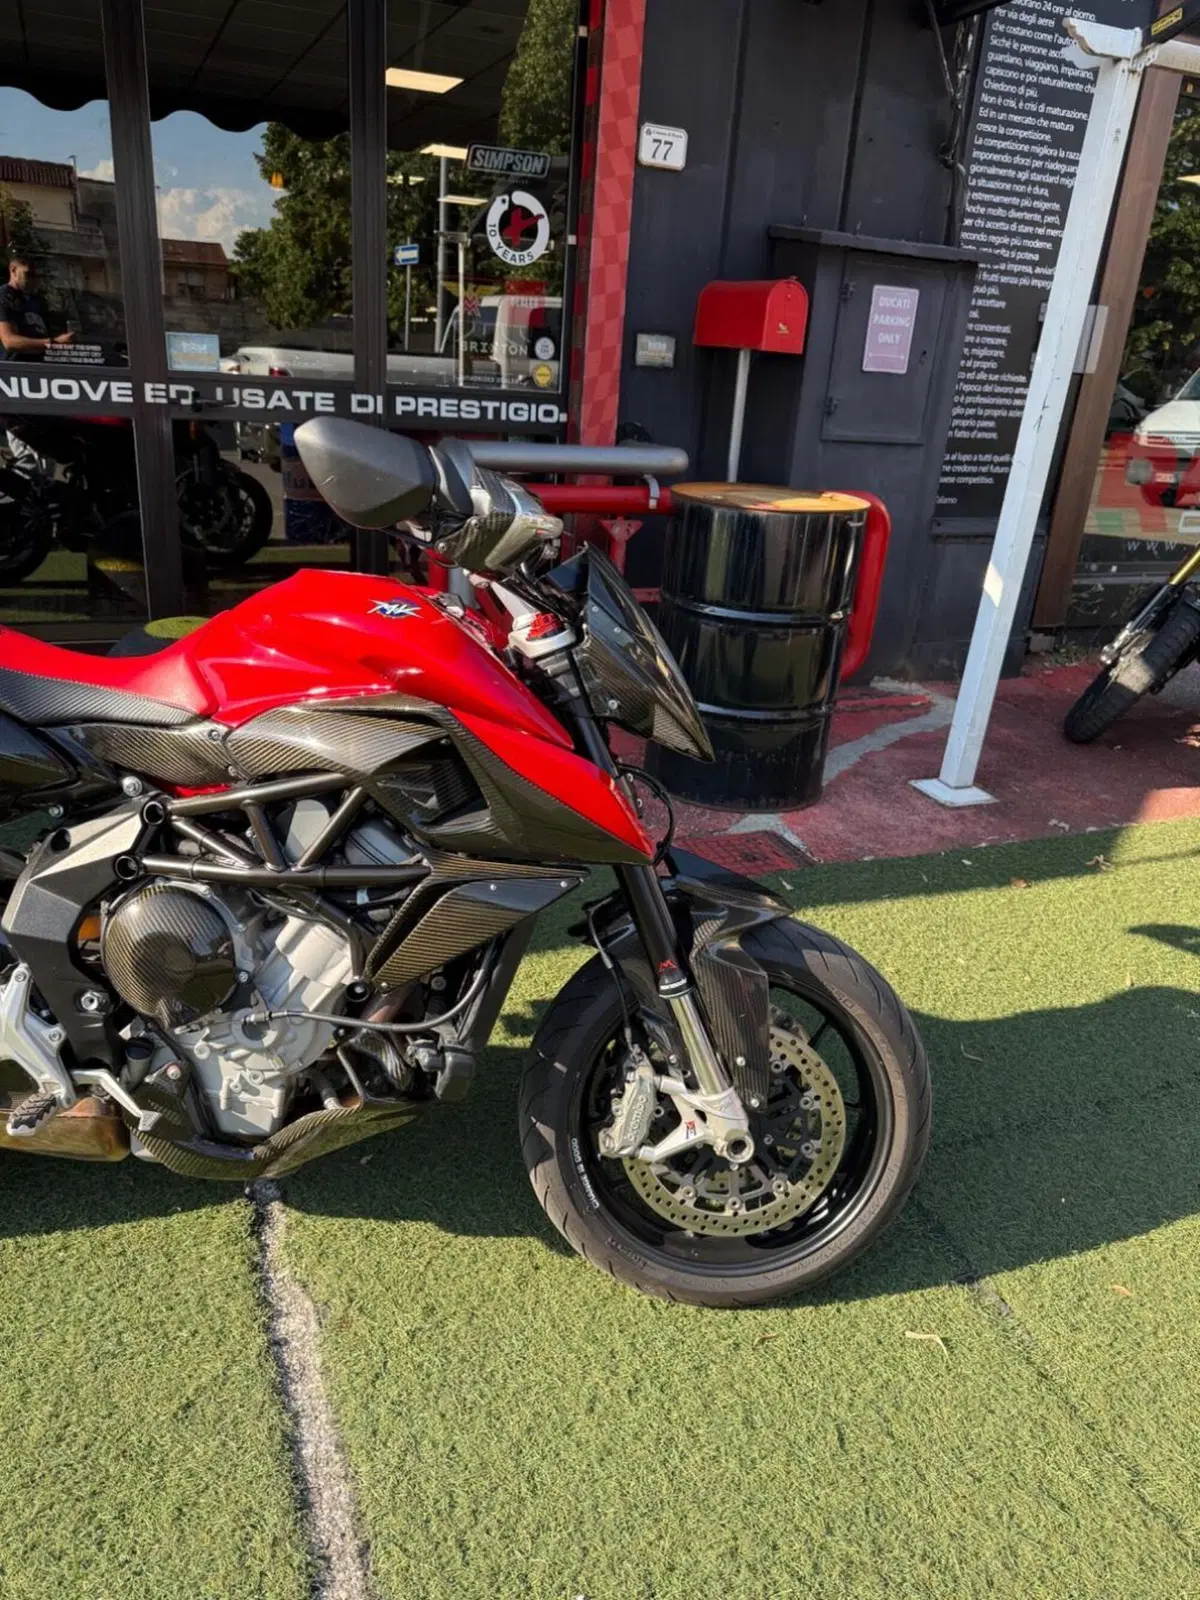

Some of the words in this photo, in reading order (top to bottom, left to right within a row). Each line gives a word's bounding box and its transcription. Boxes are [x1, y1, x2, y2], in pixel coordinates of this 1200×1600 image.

[994, 6, 1006, 17] Per
[1008, 9, 1018, 20] via
[1019, 11, 1037, 25] degli
[1042, 2, 1052, 12] 24
[1052, 5, 1065, 14] ore
[1065, 6, 1073, 16] al
[992, 21, 1005, 32] che
[1006, 25, 1034, 38] costano
[1034, 31, 1054, 42] come
[990, 34, 1012, 48] Sicché
[1012, 40, 1020, 50] le
[1020, 43, 1048, 56] persone
[988, 52, 1024, 67] guardano,
[1024, 58, 1060, 75] viaggiano,
[983, 78, 1018, 92] Chiedono
[1018, 85, 1025, 95] di
[985, 66, 1020, 80] capiscono
[1026, 74, 1037, 84] poi
[1038, 76, 1084, 92] naturalmente
[980, 92, 996, 104] Non
[997, 96, 1002, 105] è
[1002, 98, 1018, 110] crisi,
[1018, 99, 1024, 109] è
[1024, 101, 1038, 112] crisi
[1038, 102, 1046, 112] di
[976, 122, 997, 132] cresce
[998, 124, 1005, 134] la
[978, 106, 989, 117] Ed
[989, 108, 996, 118] in
[997, 112, 1007, 120] un
[1008, 112, 1036, 125] mercato
[1036, 116, 1050, 128] che
[1050, 120, 1075, 132] matura
[651, 138, 674, 161] 77
[974, 134, 983, 145] La
[984, 138, 1030, 152] competizione
[1030, 144, 1058, 157] migliora
[1058, 148, 1066, 158] la
[1066, 150, 1080, 160] razz
[474, 148, 545, 174] SIMPSON
[972, 148, 1012, 162] imponendo
[1032, 158, 1044, 169] per
[970, 163, 1016, 178] giornalmente
[1016, 169, 1030, 182] agli
[1030, 171, 1060, 184] standard
[968, 176, 976, 186] La
[977, 178, 1012, 191] situazione
[1012, 182, 1026, 193] non
[1027, 184, 1032, 194] è
[972, 191, 1020, 206] estremamente
[1020, 197, 1032, 208] più
[986, 206, 1008, 218] molto
[974, 218, 984, 228] chi
[985, 220, 1010, 231] accetta
[1010, 222, 1018, 232] di
[1018, 224, 1034, 234] stare
[1034, 226, 1046, 236] nel
[988, 235, 1010, 246] regole
[1010, 236, 1022, 247] più
[495, 242, 534, 264] YEARS
[879, 296, 911, 309] DUCATI
[873, 314, 912, 328] PARKING
[878, 332, 902, 345] ONLY
[0, 376, 133, 403] NUOVE
[215, 387, 335, 412] USATE
[351, 394, 383, 414] DI
[396, 396, 568, 423] PRESTIGIO.
